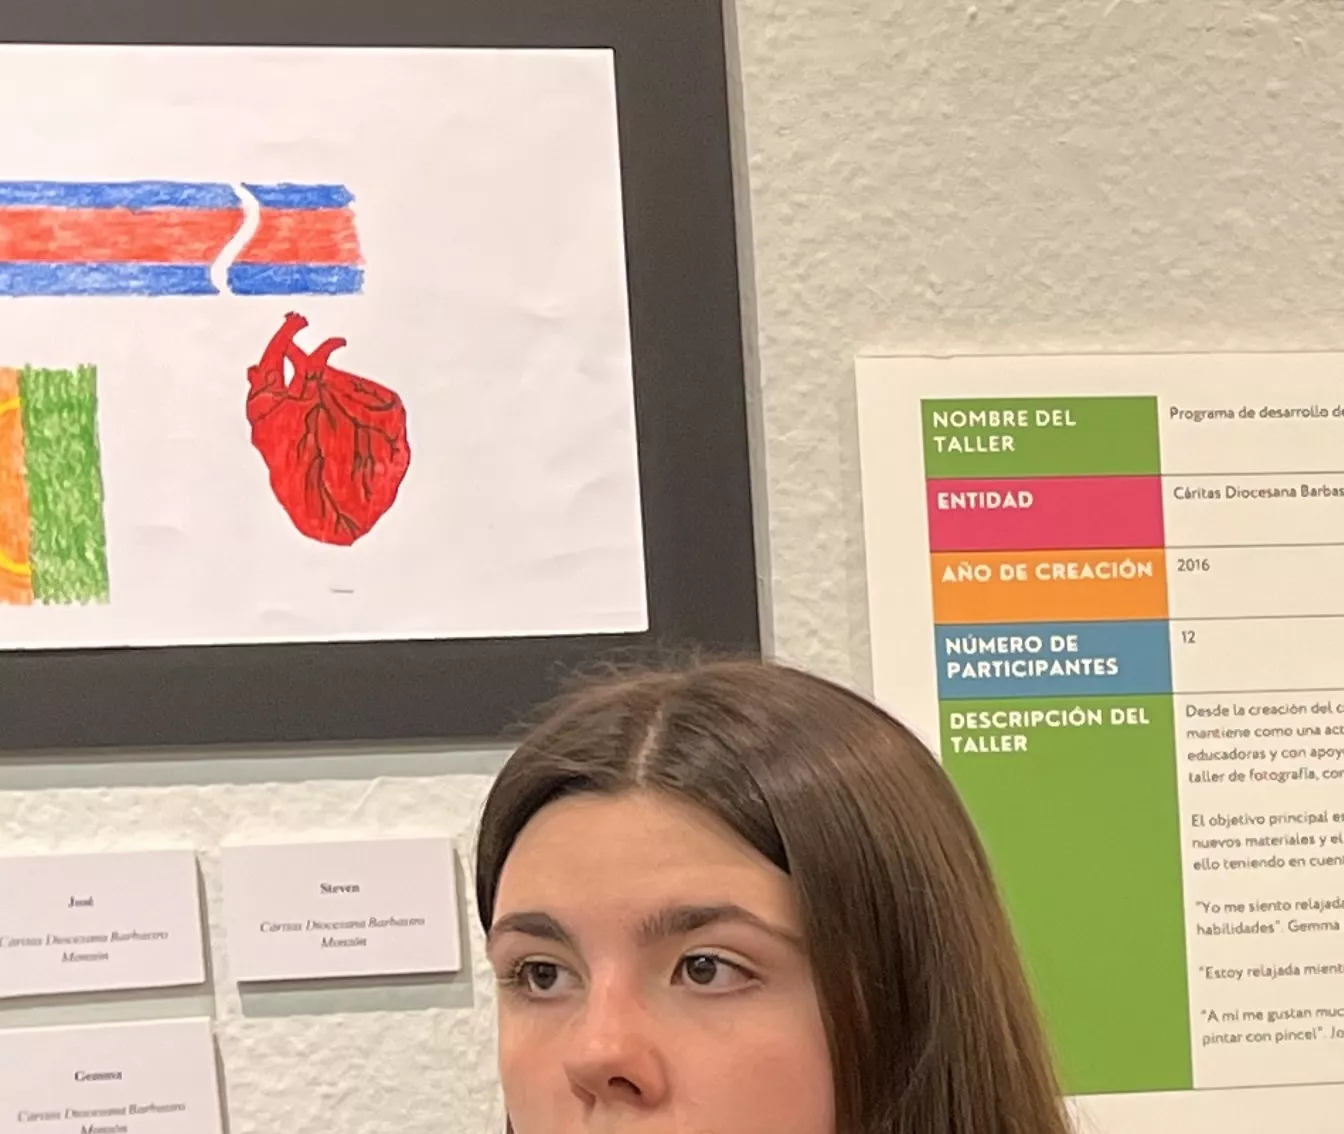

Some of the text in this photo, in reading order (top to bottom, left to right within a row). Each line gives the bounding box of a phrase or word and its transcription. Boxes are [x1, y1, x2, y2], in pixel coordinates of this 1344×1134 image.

[933, 409, 1077, 428] NOMBRE DEL
[1169, 405, 1235, 423] Programa
[1238, 405, 1256, 419] de
[1259, 404, 1328, 419] desarrollo
[933, 436, 1015, 453] TALLER
[937, 491, 1034, 510] ENTIDAD
[1173, 486, 1221, 500] Cáritas
[1226, 485, 1297, 499] Diocesana
[941, 558, 1152, 582] AÑO DE CREACIÓN
[1177, 558, 1210, 571] 2016
[945, 633, 1078, 655] NÚMERO DE
[1182, 630, 1196, 643] 12
[947, 658, 1118, 679] PARTICIPANTES
[950, 706, 1149, 730] DESCRIPCIÓN DEL
[1186, 704, 1229, 718] Desde
[1233, 704, 1245, 717] la
[1248, 703, 1307, 716] creación
[1311, 701, 1333, 715] del
[1186, 727, 1251, 739] mantiene
[1254, 727, 1293, 738] como
[1296, 726, 1321, 737] una
[951, 735, 1028, 753] TALLER
[1269, 749, 1277, 762] y
[1281, 748, 1306, 759] con
[1192, 813, 1205, 828] El
[1209, 813, 1265, 830] objetivo
[1269, 810, 1328, 827] principal
[1192, 838, 1241, 849] nuevos
[1245, 832, 1316, 847] materiales
[1319, 835, 1327, 848] y
[1330, 831, 1344, 845] el
[1224, 903, 1245, 913] me
[1249, 900, 1292, 913] siento
[1288, 919, 1340, 933] Gemma
[1247, 963, 1300, 980] relajada
[1243, 1011, 1263, 1021] me
[1267, 1008, 1312, 1024] gustan
[1202, 1033, 1243, 1047] pintar
[1246, 1032, 1272, 1043] con
